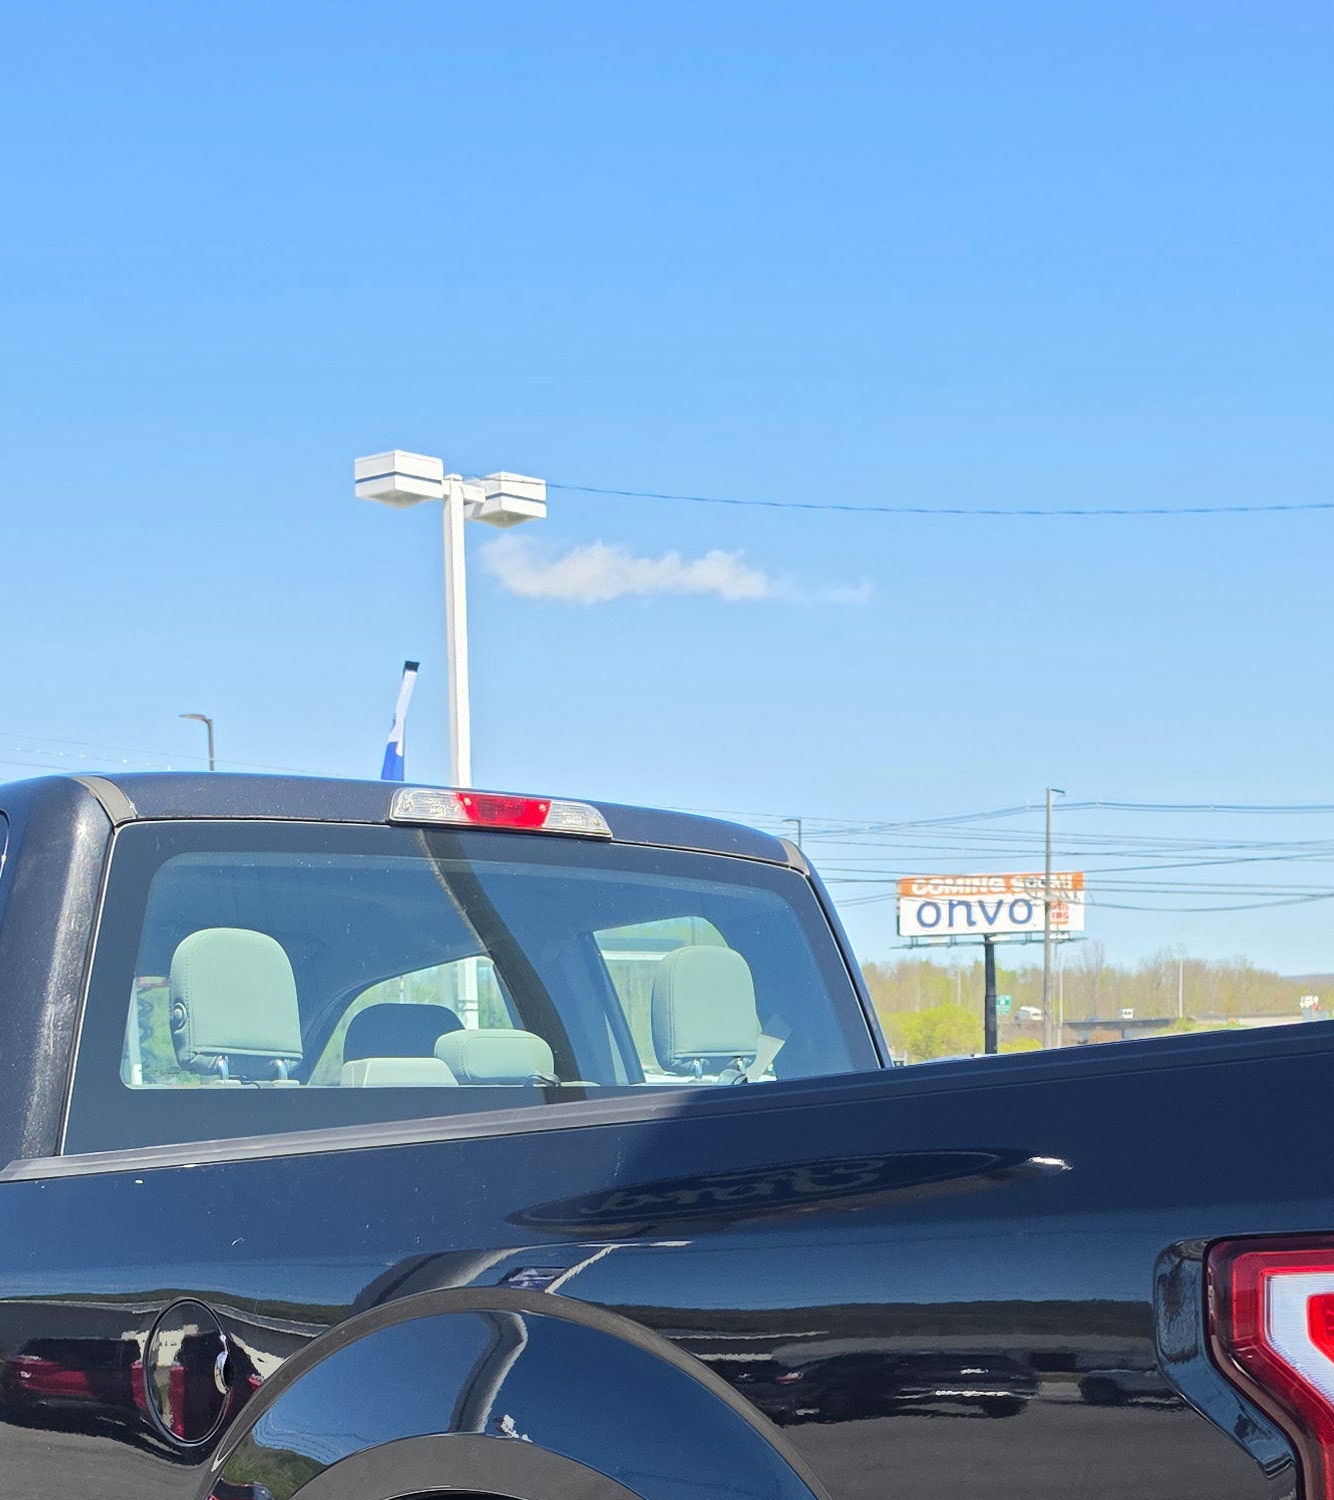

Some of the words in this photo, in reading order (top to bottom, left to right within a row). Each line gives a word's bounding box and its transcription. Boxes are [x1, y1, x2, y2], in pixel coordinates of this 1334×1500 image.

[911, 876, 1007, 896] COMING
[1010, 873, 1073, 892] SOON
[917, 898, 1033, 928] onvo
